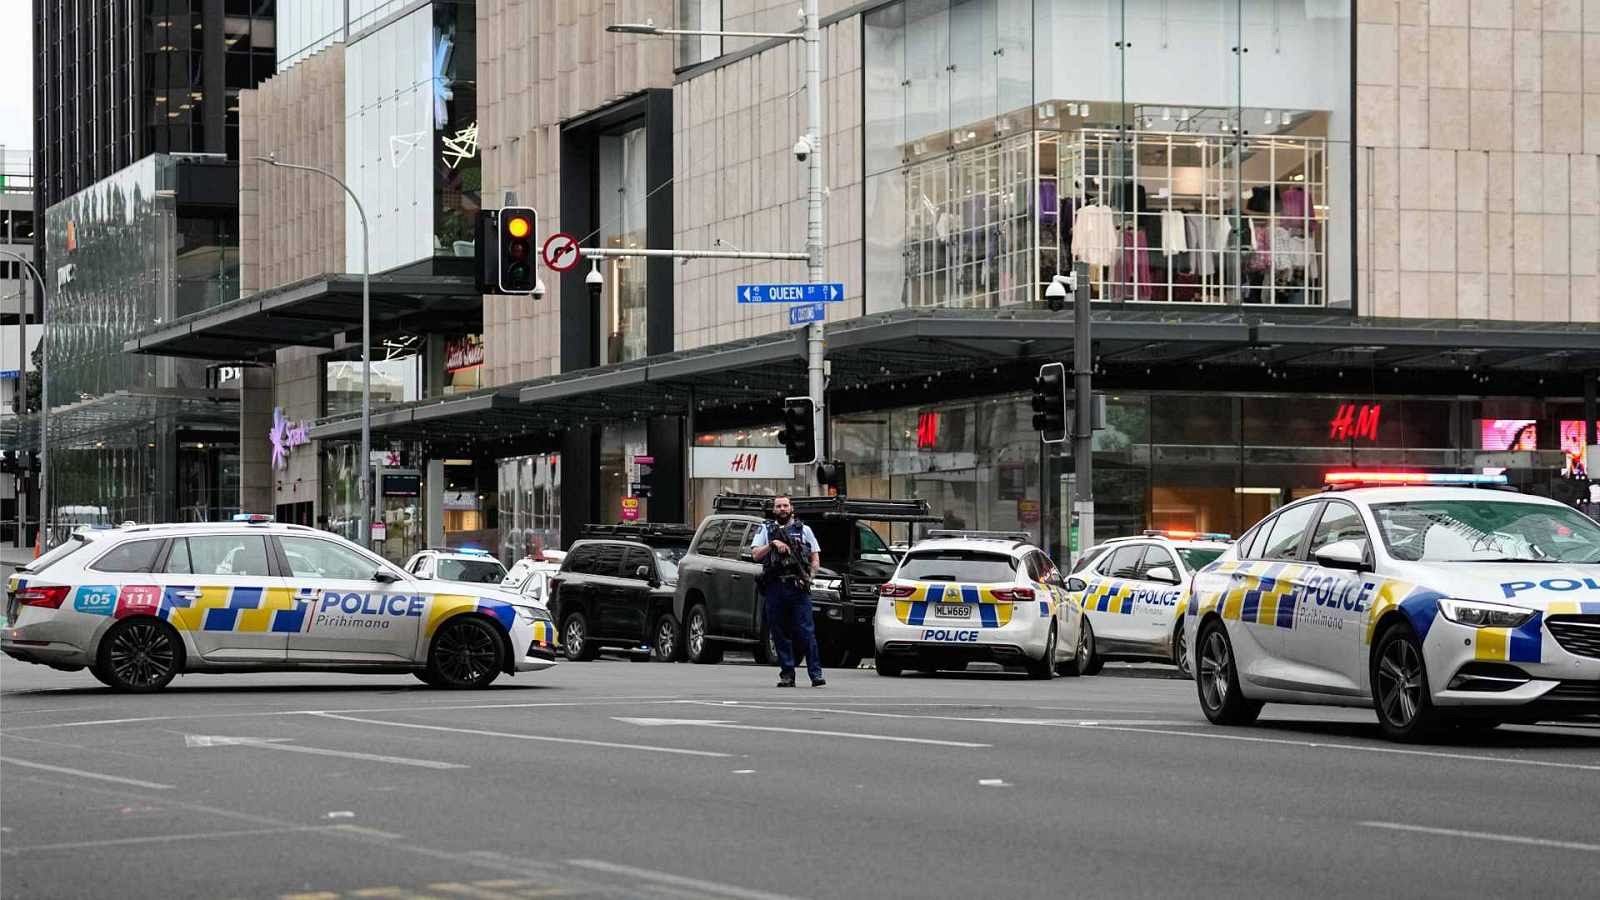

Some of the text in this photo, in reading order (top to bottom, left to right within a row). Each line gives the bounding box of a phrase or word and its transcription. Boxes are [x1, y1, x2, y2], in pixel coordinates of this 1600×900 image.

[769, 286, 803, 300] QUEEN
[1330, 404, 1381, 440] H&M
[731, 453, 758, 472] H&M
[83, 594, 111, 605] 105
[127, 593, 153, 605] 111
[1138, 591, 1180, 606] POLICE
[1303, 577, 1375, 612] POLICE
[320, 592, 425, 616] POLICE
[936, 606, 969, 616] MLW669
[316, 614, 390, 629] Pirihimana
[1299, 607, 1343, 629] Pirihimana
[924, 630, 979, 642] POLICE
